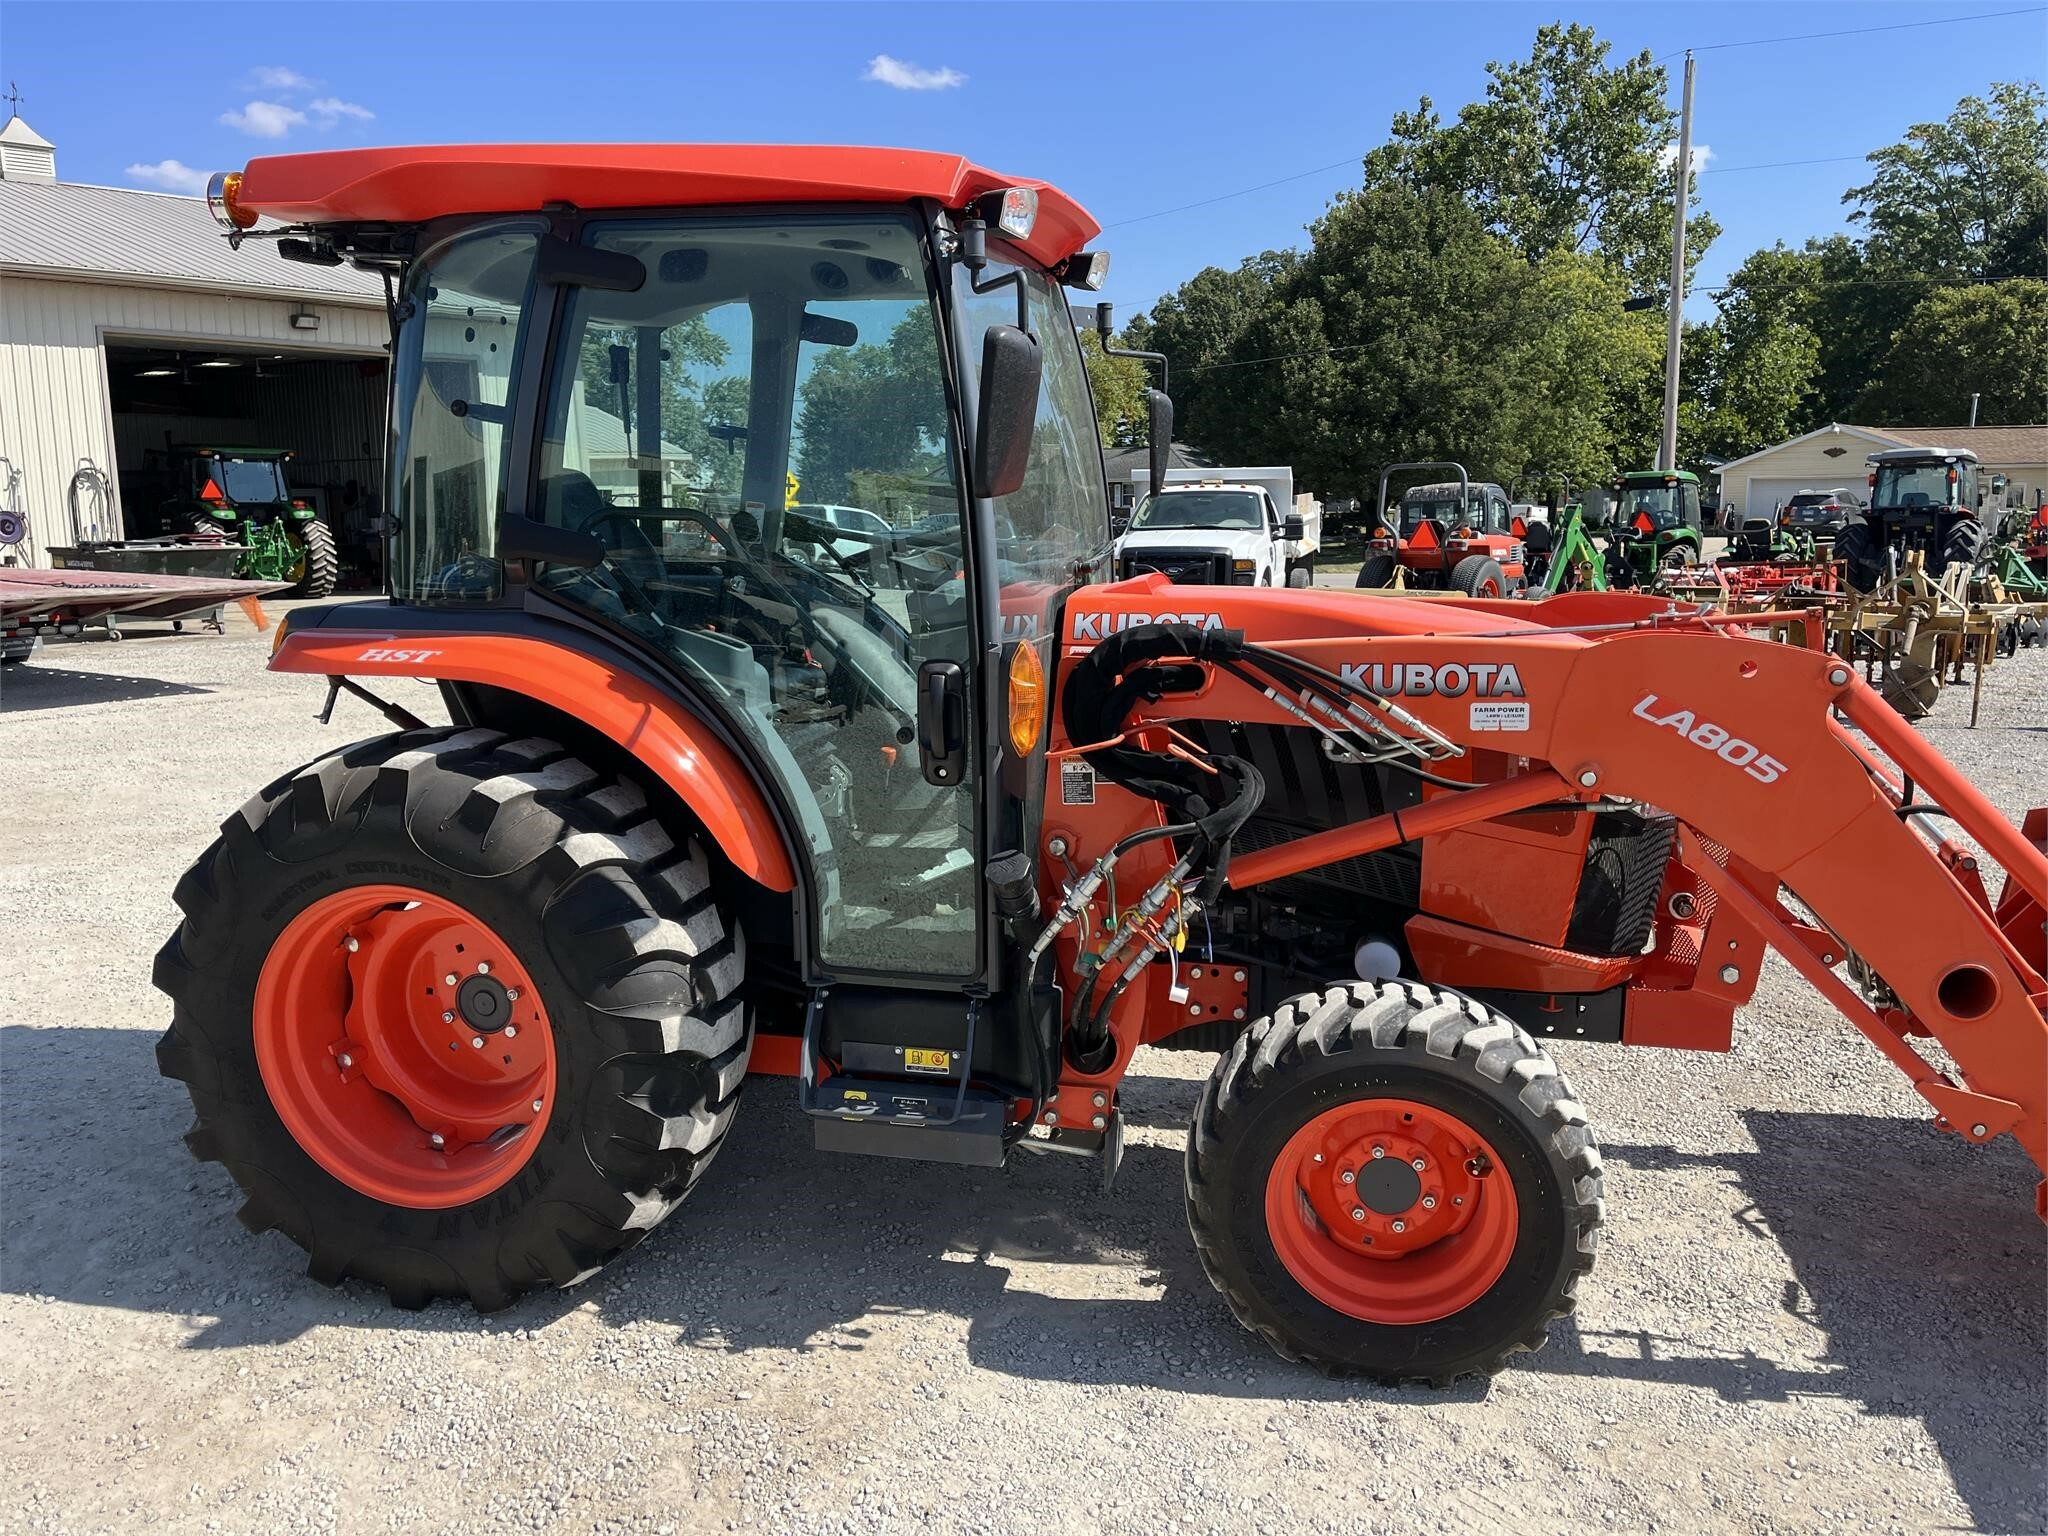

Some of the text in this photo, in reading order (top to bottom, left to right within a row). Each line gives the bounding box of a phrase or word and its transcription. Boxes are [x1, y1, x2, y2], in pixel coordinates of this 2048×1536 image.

[356, 648, 443, 663] HST
[1340, 663, 1526, 698] KUBOTA
[1632, 694, 1789, 784] LA805
